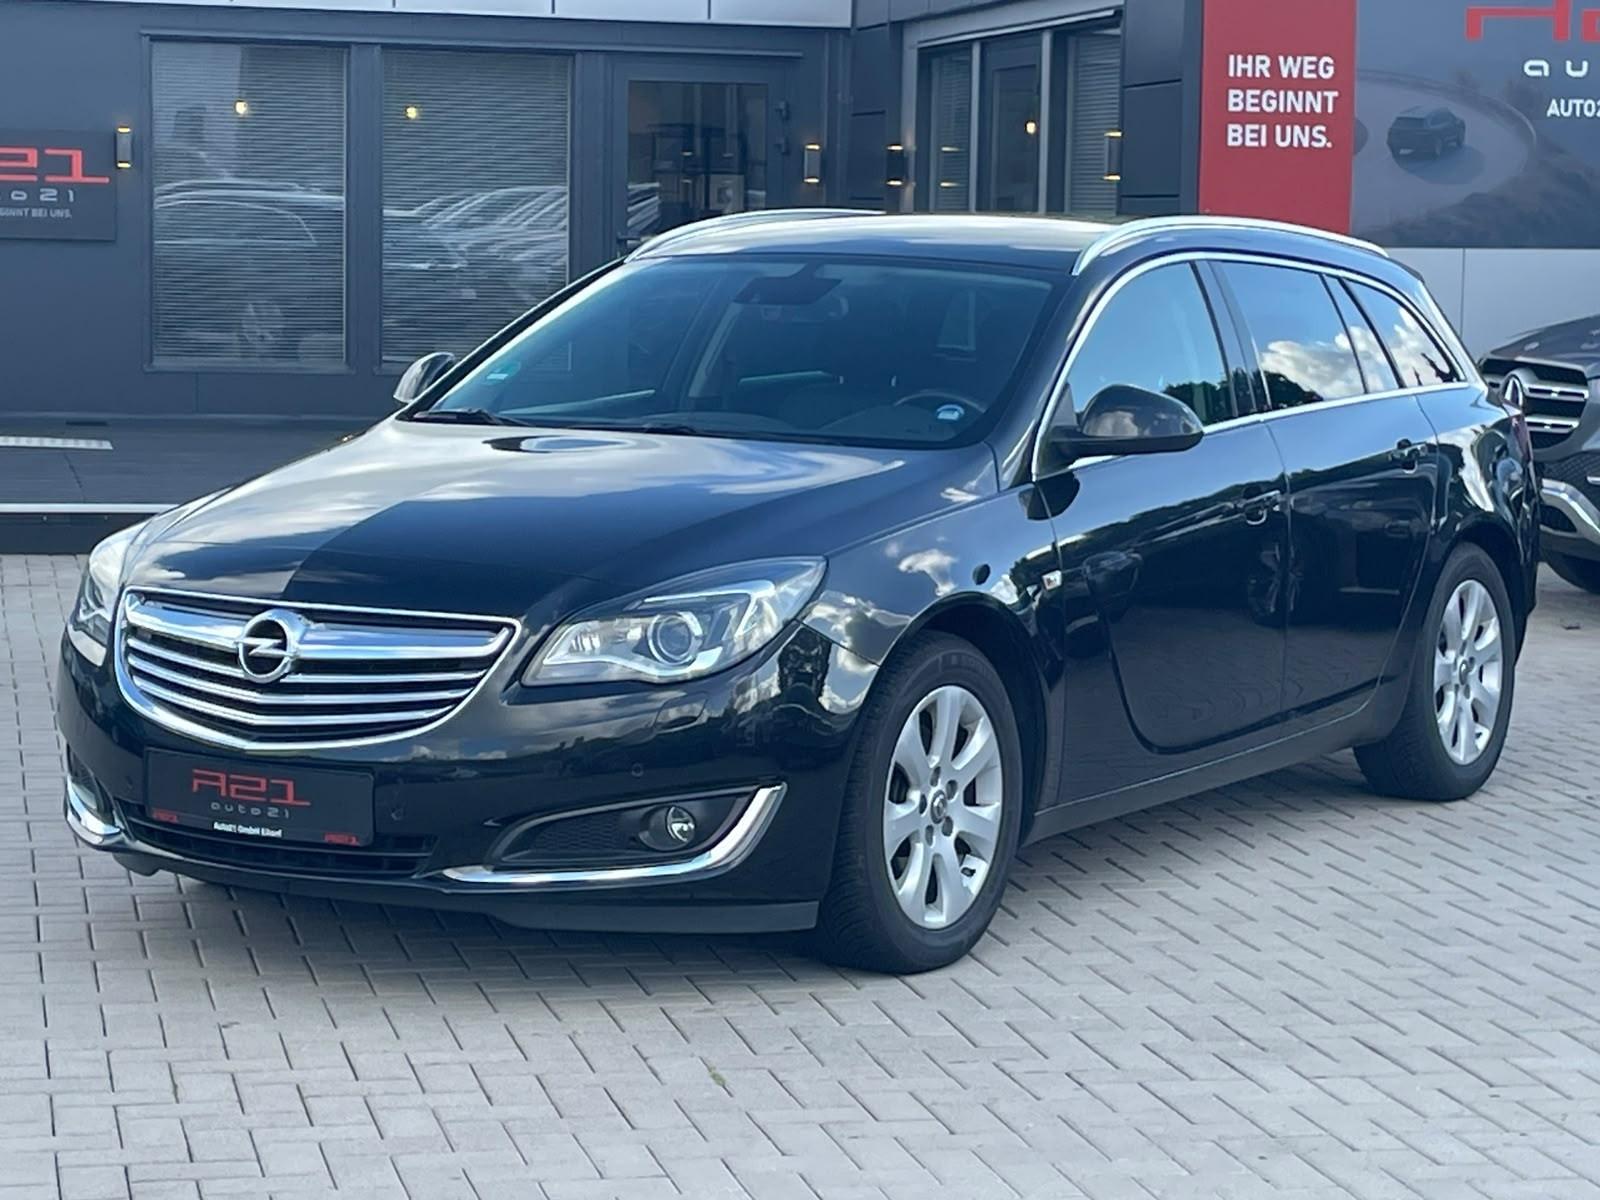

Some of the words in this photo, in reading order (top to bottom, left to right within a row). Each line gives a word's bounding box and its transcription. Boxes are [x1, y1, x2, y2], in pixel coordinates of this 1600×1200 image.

[1228, 54, 1271, 78] IHR
[1278, 55, 1335, 79] WEG
[1227, 88, 1339, 114] BEGINNT
[1546, 98, 1600, 118] AUTO
[1227, 123, 1267, 147] BEI
[1275, 124, 1333, 148] UNS.
[0, 147, 110, 183] 21
[192, 769, 311, 806] A21
[211, 801, 290, 819] auto21
